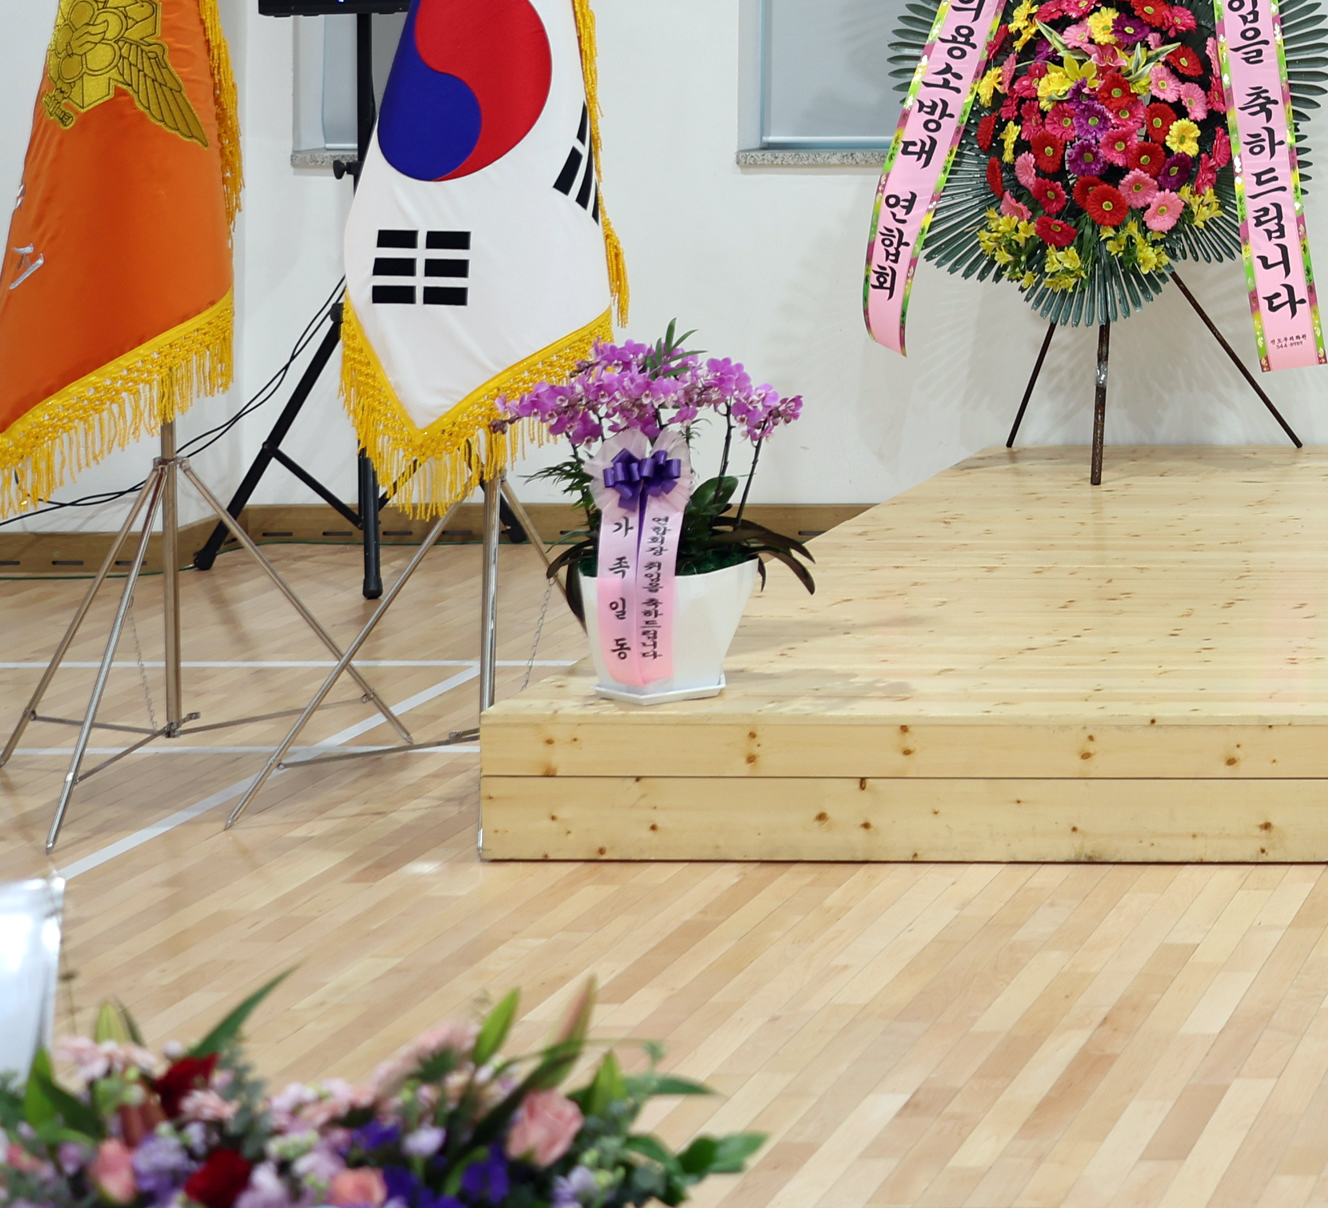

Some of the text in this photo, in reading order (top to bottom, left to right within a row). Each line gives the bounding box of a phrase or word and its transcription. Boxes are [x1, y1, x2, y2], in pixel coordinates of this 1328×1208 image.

[870, 190, 917, 302] 연합회
[1238, 85, 1306, 321] 축하드립니다
[640, 516, 672, 660] 연합회장 취임을 축하드립니다
